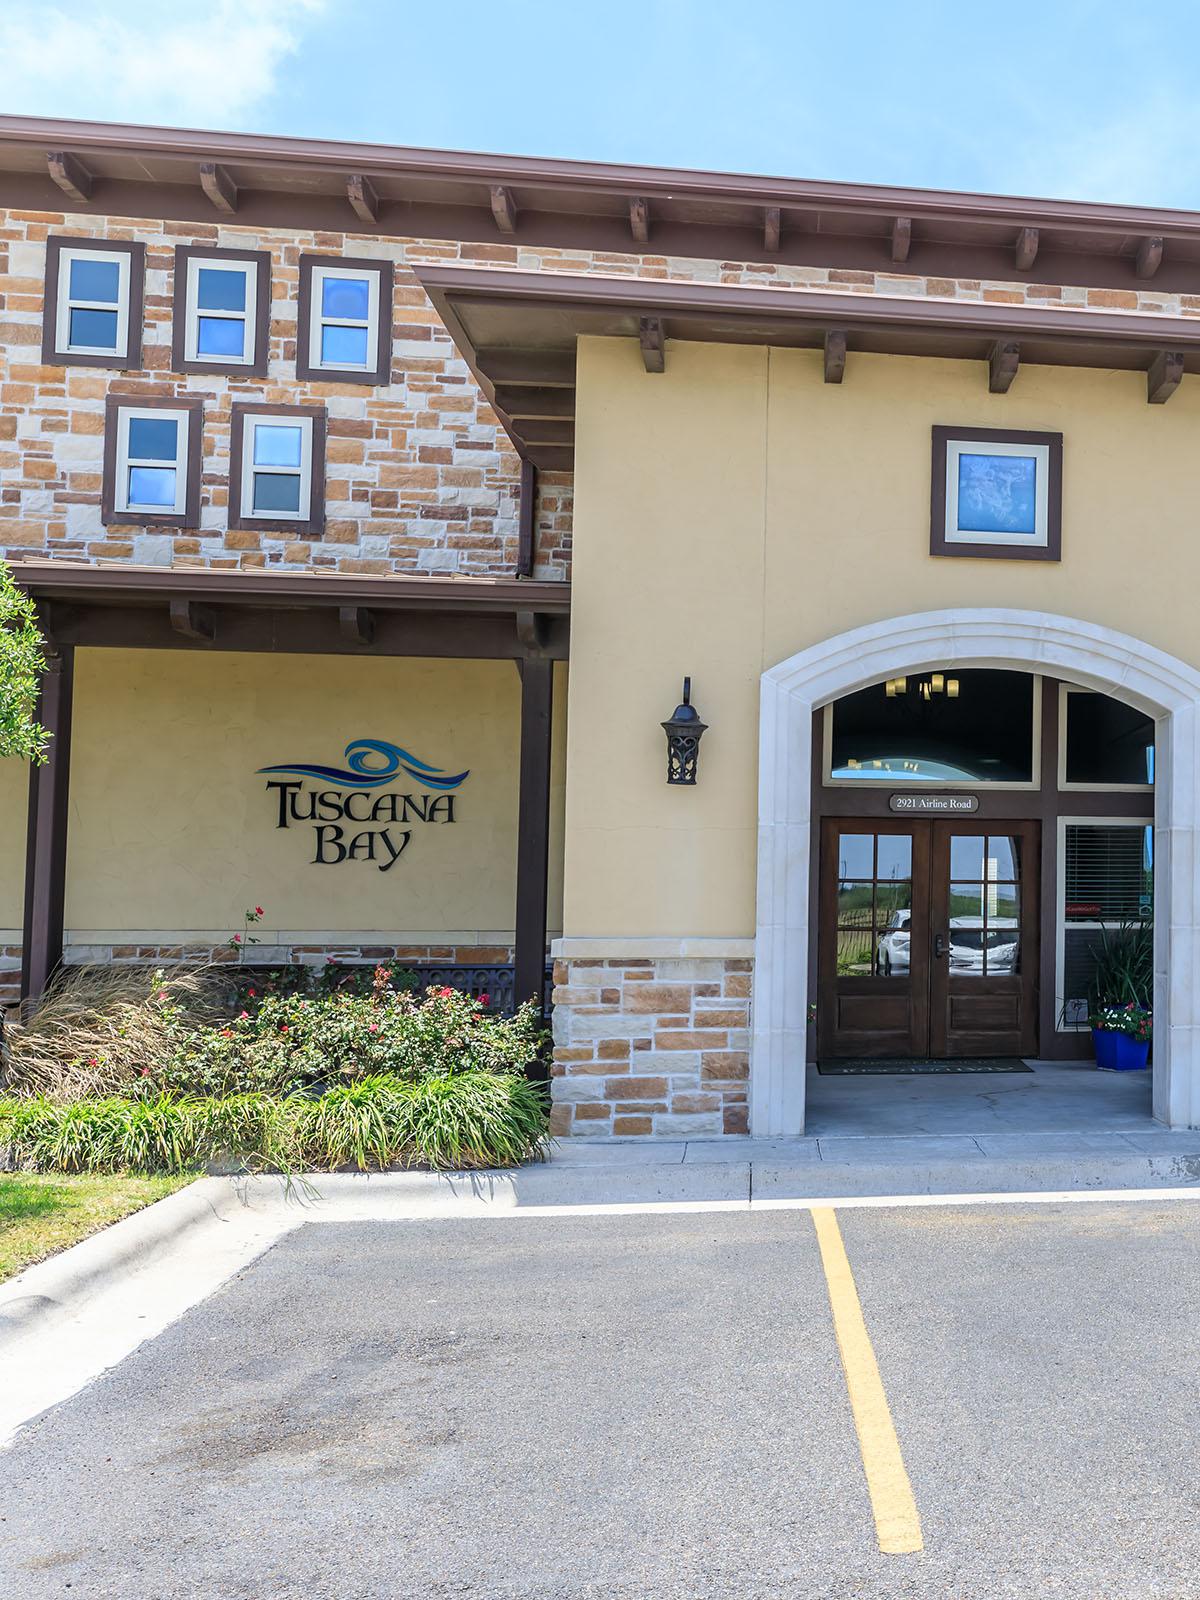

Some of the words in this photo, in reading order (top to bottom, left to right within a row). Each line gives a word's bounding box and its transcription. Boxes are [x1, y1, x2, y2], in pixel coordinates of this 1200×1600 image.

[266, 780, 457, 829] TUSCANA
[896, 798, 916, 808] 2921
[918, 798, 948, 809] Airline
[949, 799, 972, 809] Road
[310, 825, 412, 872] BAY
